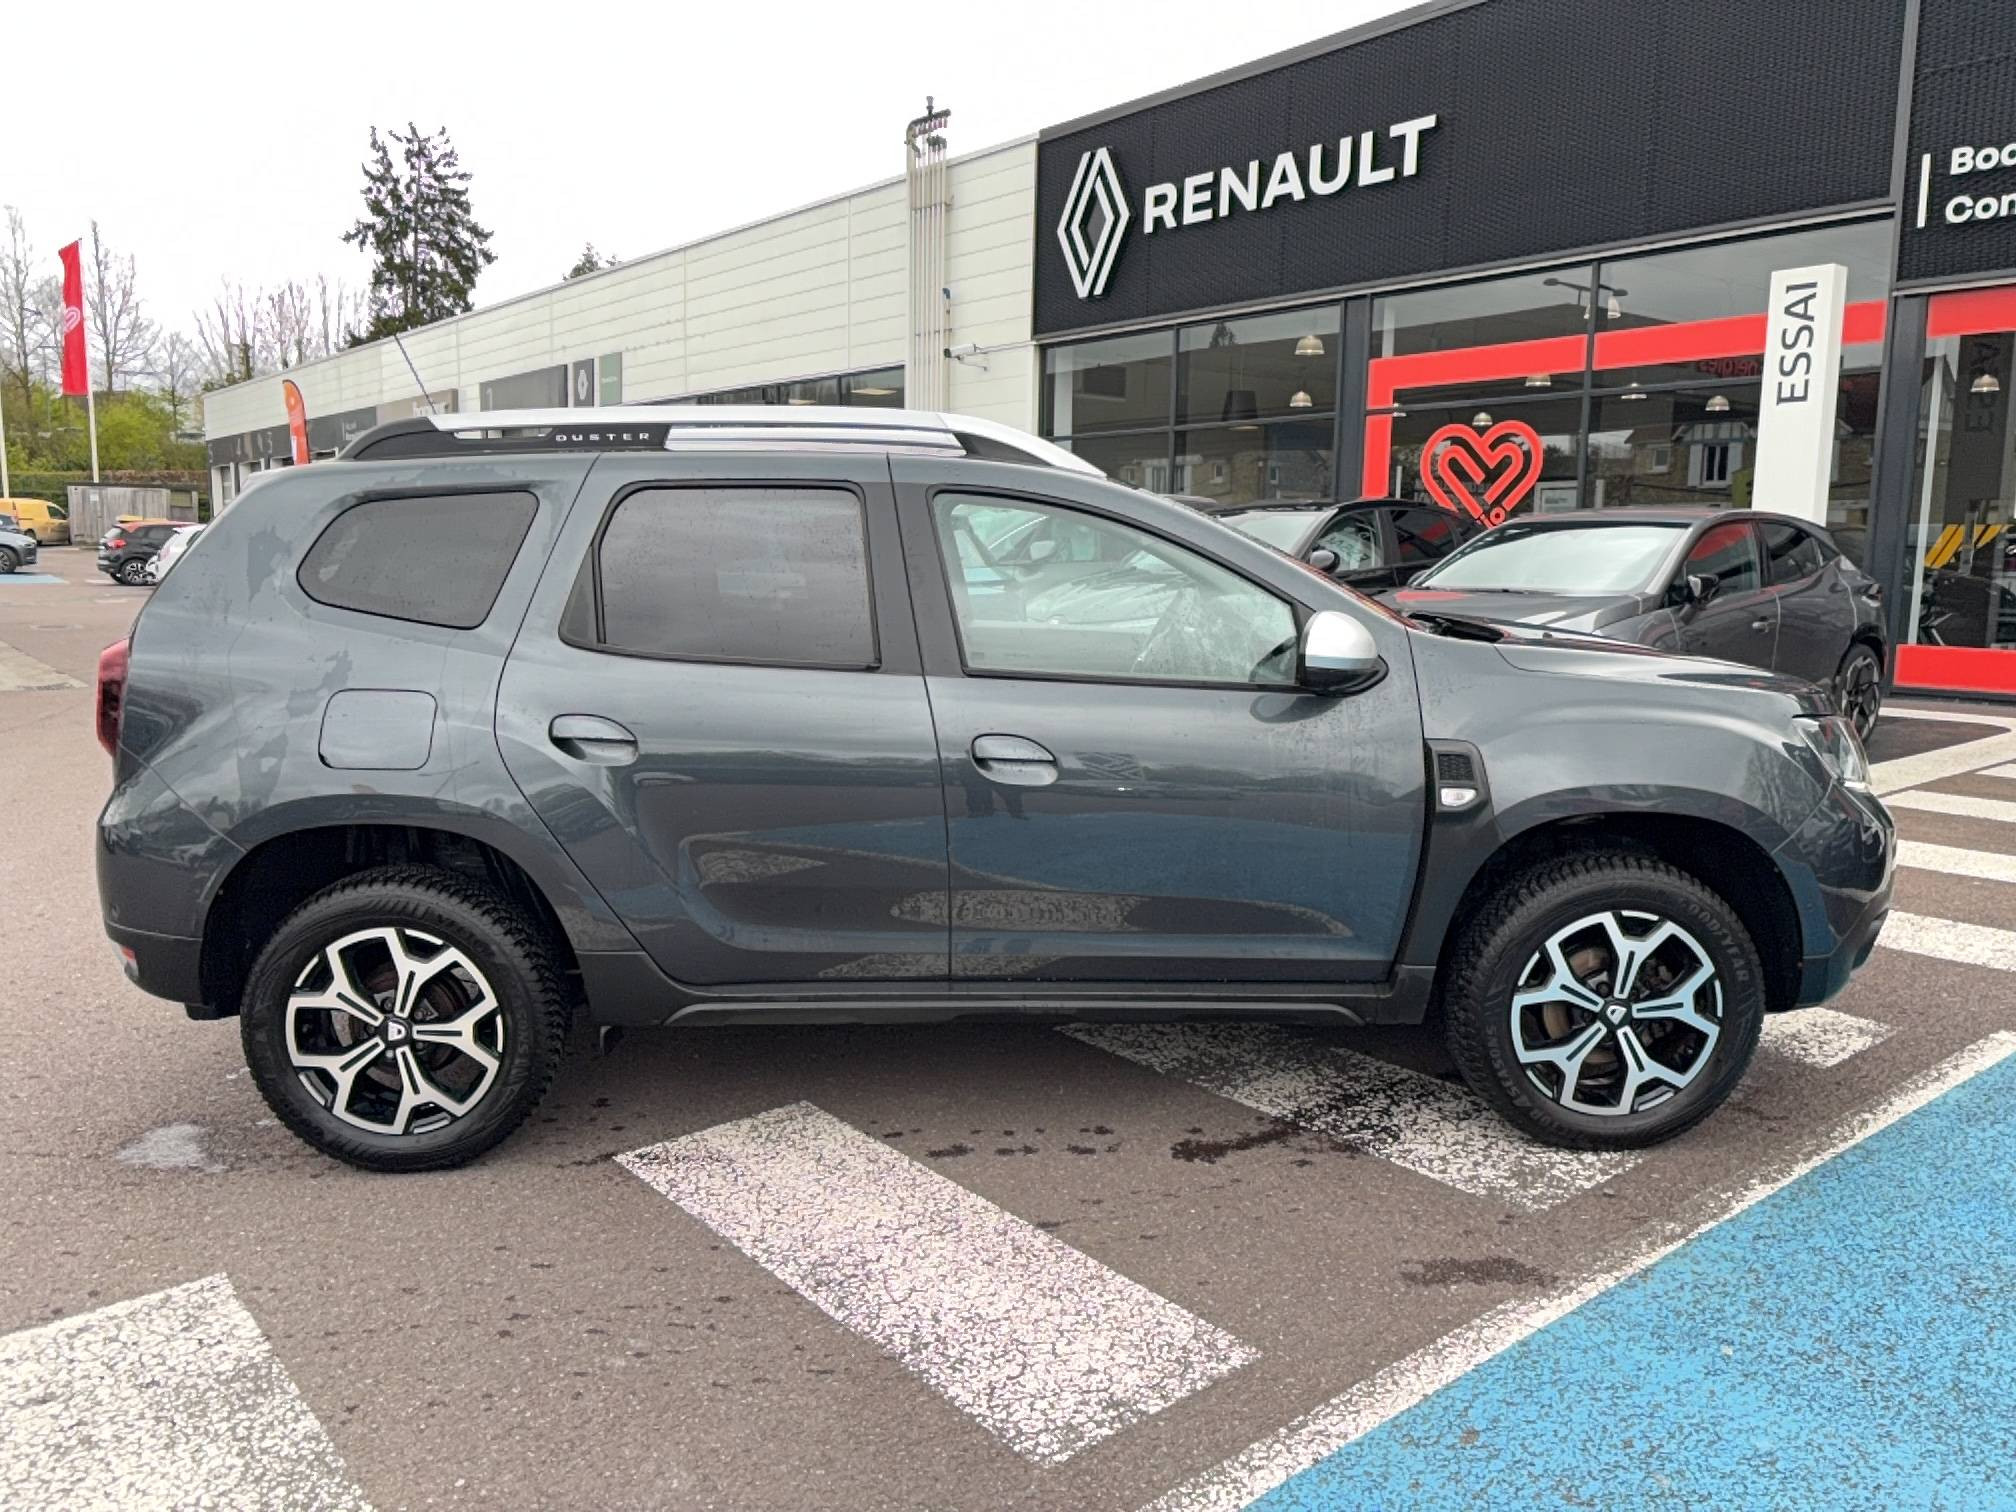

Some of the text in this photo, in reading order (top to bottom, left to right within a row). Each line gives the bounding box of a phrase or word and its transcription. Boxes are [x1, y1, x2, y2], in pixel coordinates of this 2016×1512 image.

[1144, 113, 1437, 234] RENAULT
[1776, 281, 1818, 406] ESSAI
[555, 432, 649, 442] DUSTER
